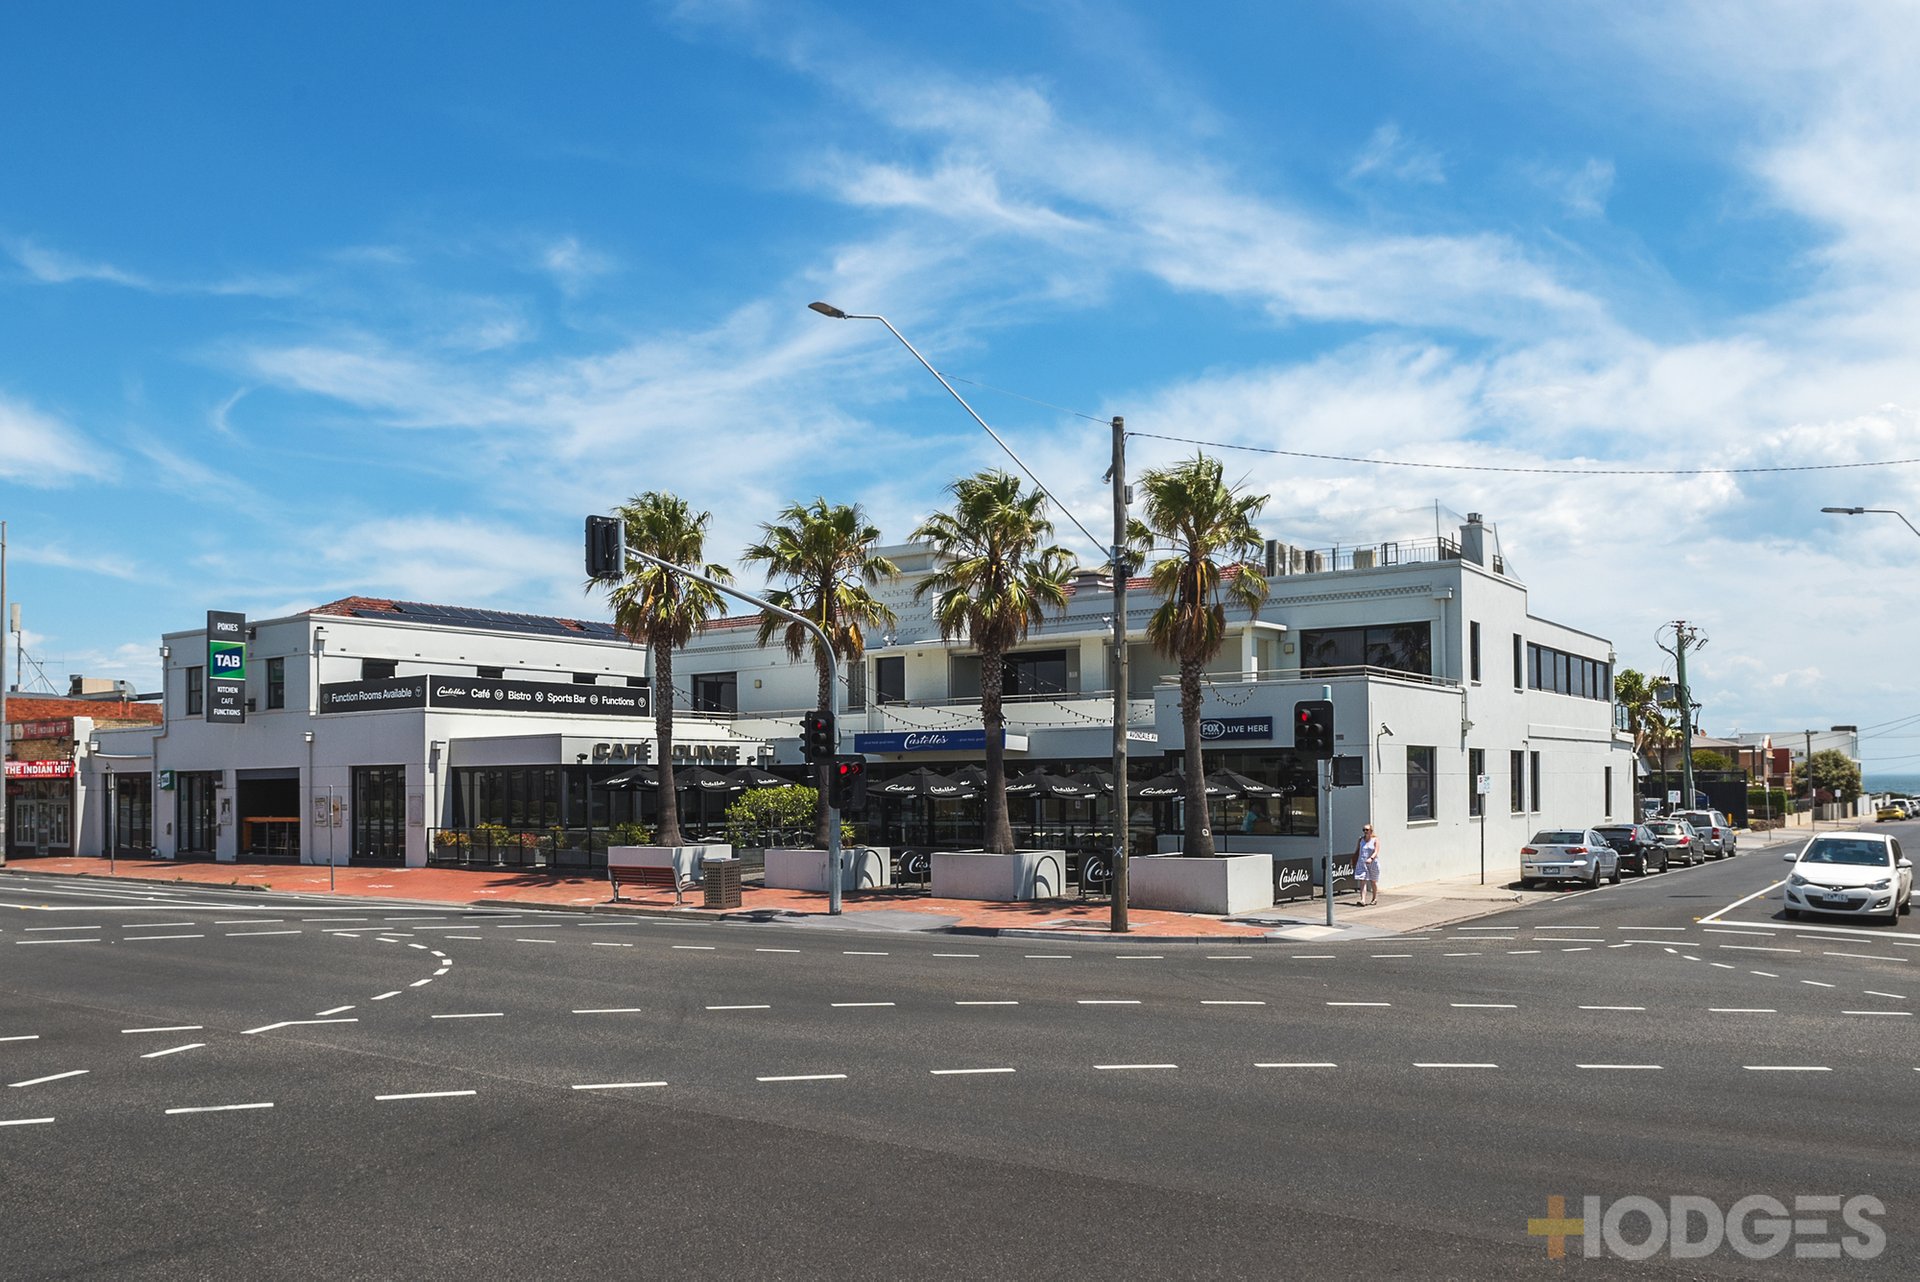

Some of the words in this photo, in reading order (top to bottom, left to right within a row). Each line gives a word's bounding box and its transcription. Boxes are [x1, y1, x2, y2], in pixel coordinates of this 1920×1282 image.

[217, 622, 239, 632] POKIES
[215, 654, 240, 668] TAB
[217, 686, 238, 694] KITCHEN
[331, 692, 358, 703] Function
[359, 690, 382, 701] Rooms
[383, 687, 412, 699] Available
[221, 697, 234, 705] CAFE
[471, 688, 490, 699] Café
[508, 690, 531, 700] Bistro
[547, 692, 573, 704] Sports
[574, 693, 587, 704] Bar
[602, 695, 635, 706] Functions
[213, 708, 240, 716] FUNCTIONS
[1202, 723, 1220, 733] FOX
[1227, 725, 1244, 733] LIVE
[1247, 724, 1269, 732] HERE
[903, 733, 949, 750] Castello's
[593, 738, 652, 760] CAFÉ
[671, 744, 740, 760] OUNGE
[5, 766, 22, 774] THE
[23, 766, 53, 774] INDIAN
